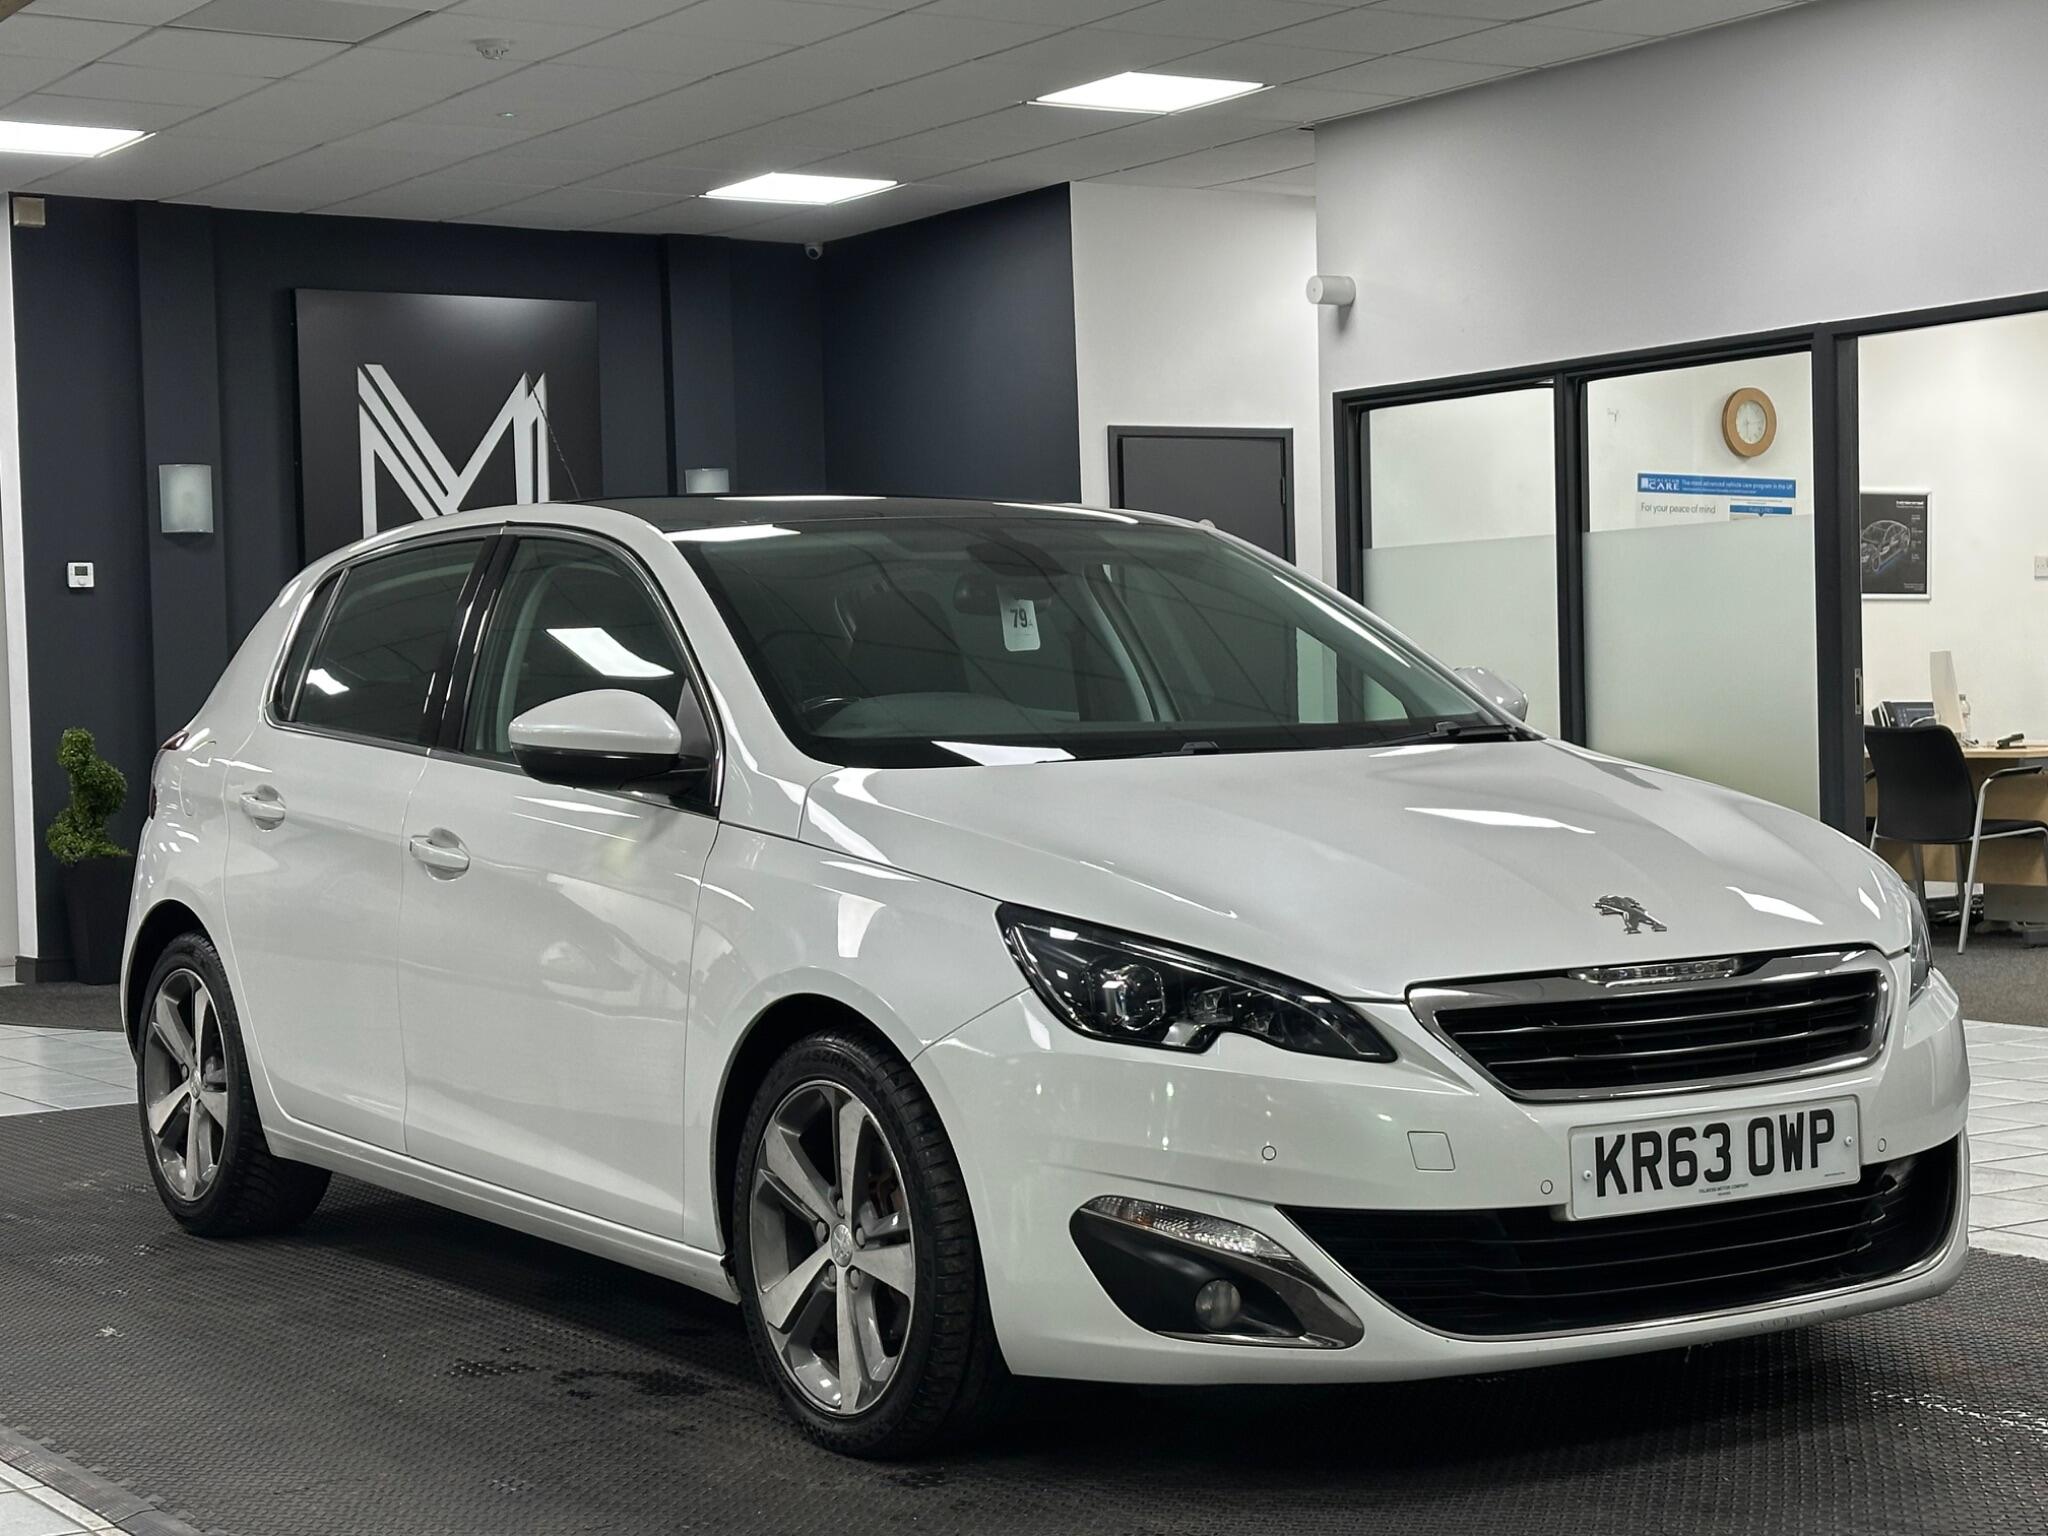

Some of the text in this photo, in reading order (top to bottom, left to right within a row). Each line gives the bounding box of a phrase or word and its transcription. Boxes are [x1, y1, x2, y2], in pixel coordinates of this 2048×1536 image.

[357, 364, 550, 539] M
[1649, 482, 1680, 491] CARE
[1641, 502, 1716, 515] For your peace of mind
[1010, 608, 1028, 628] 79
[1595, 1108, 1835, 1197] KR63 OWP
